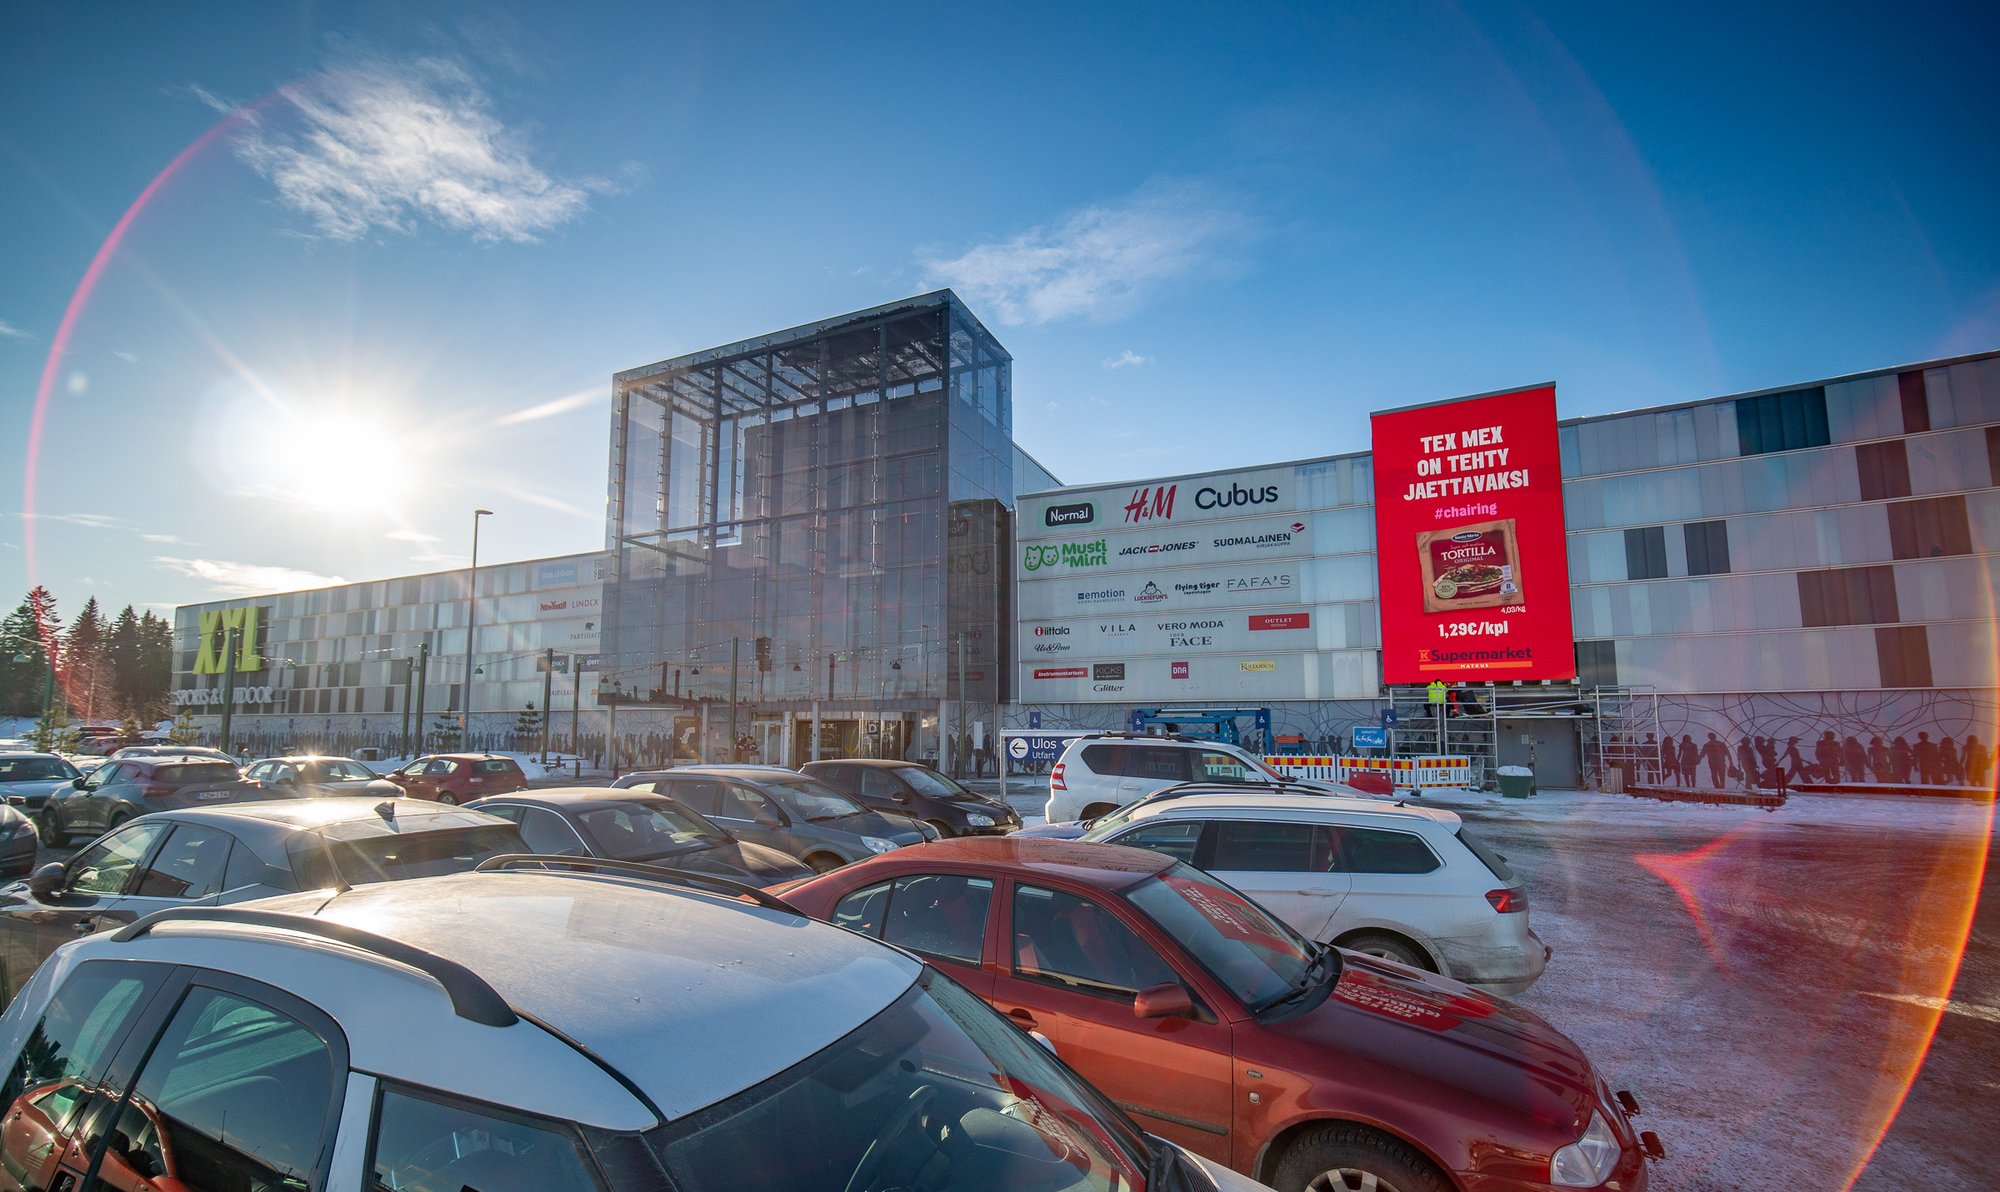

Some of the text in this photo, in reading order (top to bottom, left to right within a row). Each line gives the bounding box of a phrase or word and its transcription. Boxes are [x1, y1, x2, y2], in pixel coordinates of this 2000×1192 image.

[1420, 426, 1503, 453] TEX MEX
[1417, 448, 1509, 476] ON TEHTY
[1403, 469, 1529, 500] JAETTAVAKSI
[1195, 482, 1278, 509] Cubus
[1124, 485, 1177, 523] H&M
[1434, 503, 1497, 519] #chairing
[1050, 507, 1088, 522] Normal
[1213, 533, 1291, 547] SUOMALAINEN
[1062, 540, 1107, 555] Musti
[1119, 546, 1148, 555] JACK
[1160, 541, 1196, 552] JONES
[1441, 545, 1496, 560] TORTILLA
[1069, 553, 1107, 567] Mirri
[1175, 583, 1198, 591] flying
[1227, 575, 1291, 588] FAFA'S
[1085, 588, 1125, 599] emotion
[572, 598, 599, 608] LINDEX
[1500, 606, 1526, 614] 4,03/kg
[1044, 626, 1070, 636] iittala
[1100, 624, 1136, 632] VILA
[1157, 620, 1224, 630] VERO MODA
[1438, 621, 1508, 638] 1,29€/kpl
[192, 606, 260, 674] XXL
[1170, 636, 1212, 646] FACE
[1431, 647, 1533, 662] Supermarket
[1093, 684, 1124, 692] Glitter
[1032, 738, 1057, 749] Ulos
[1032, 751, 1055, 759] Utfart
